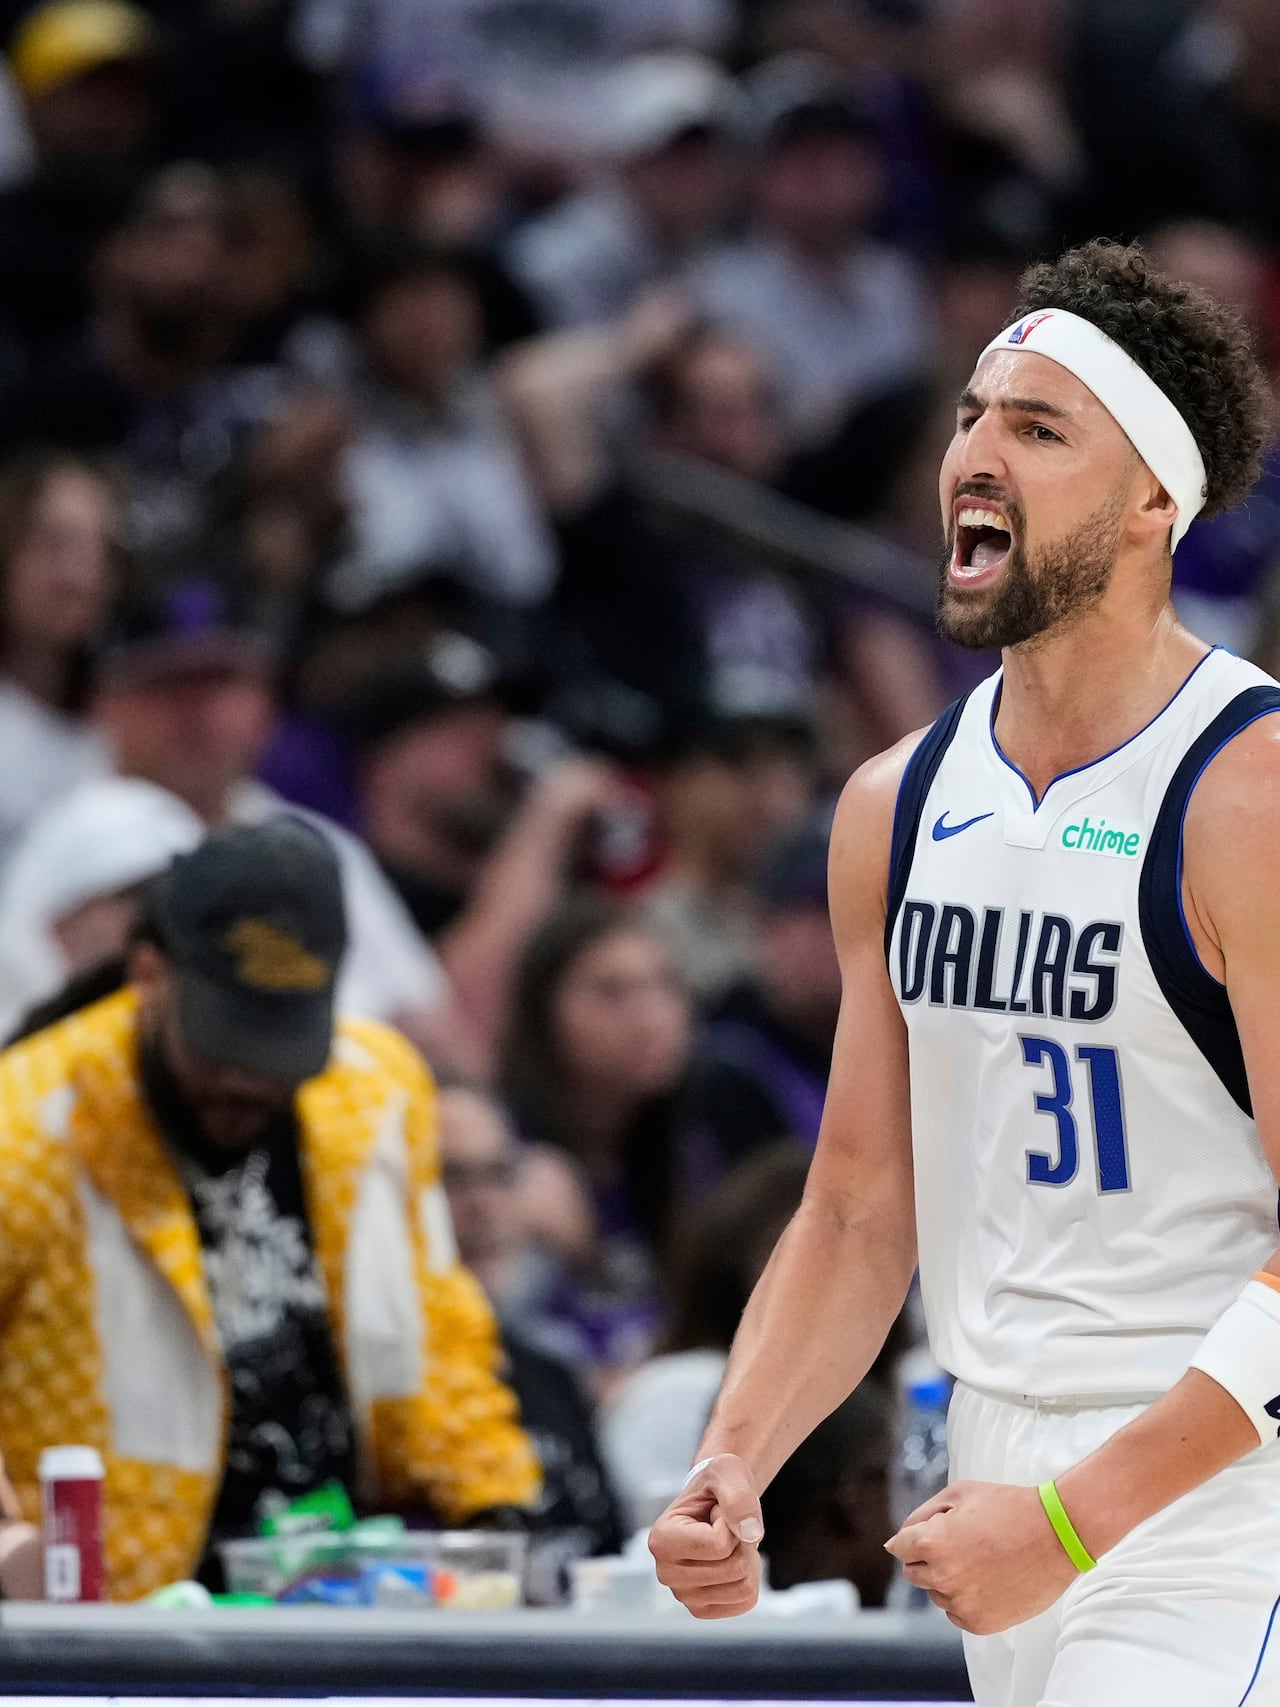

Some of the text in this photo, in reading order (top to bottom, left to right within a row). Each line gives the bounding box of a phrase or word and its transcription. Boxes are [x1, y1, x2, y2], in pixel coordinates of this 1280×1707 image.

[1062, 818, 1140, 856] chime
[899, 899, 1125, 1025] DALLAS
[1017, 1033, 1133, 1196] 31
